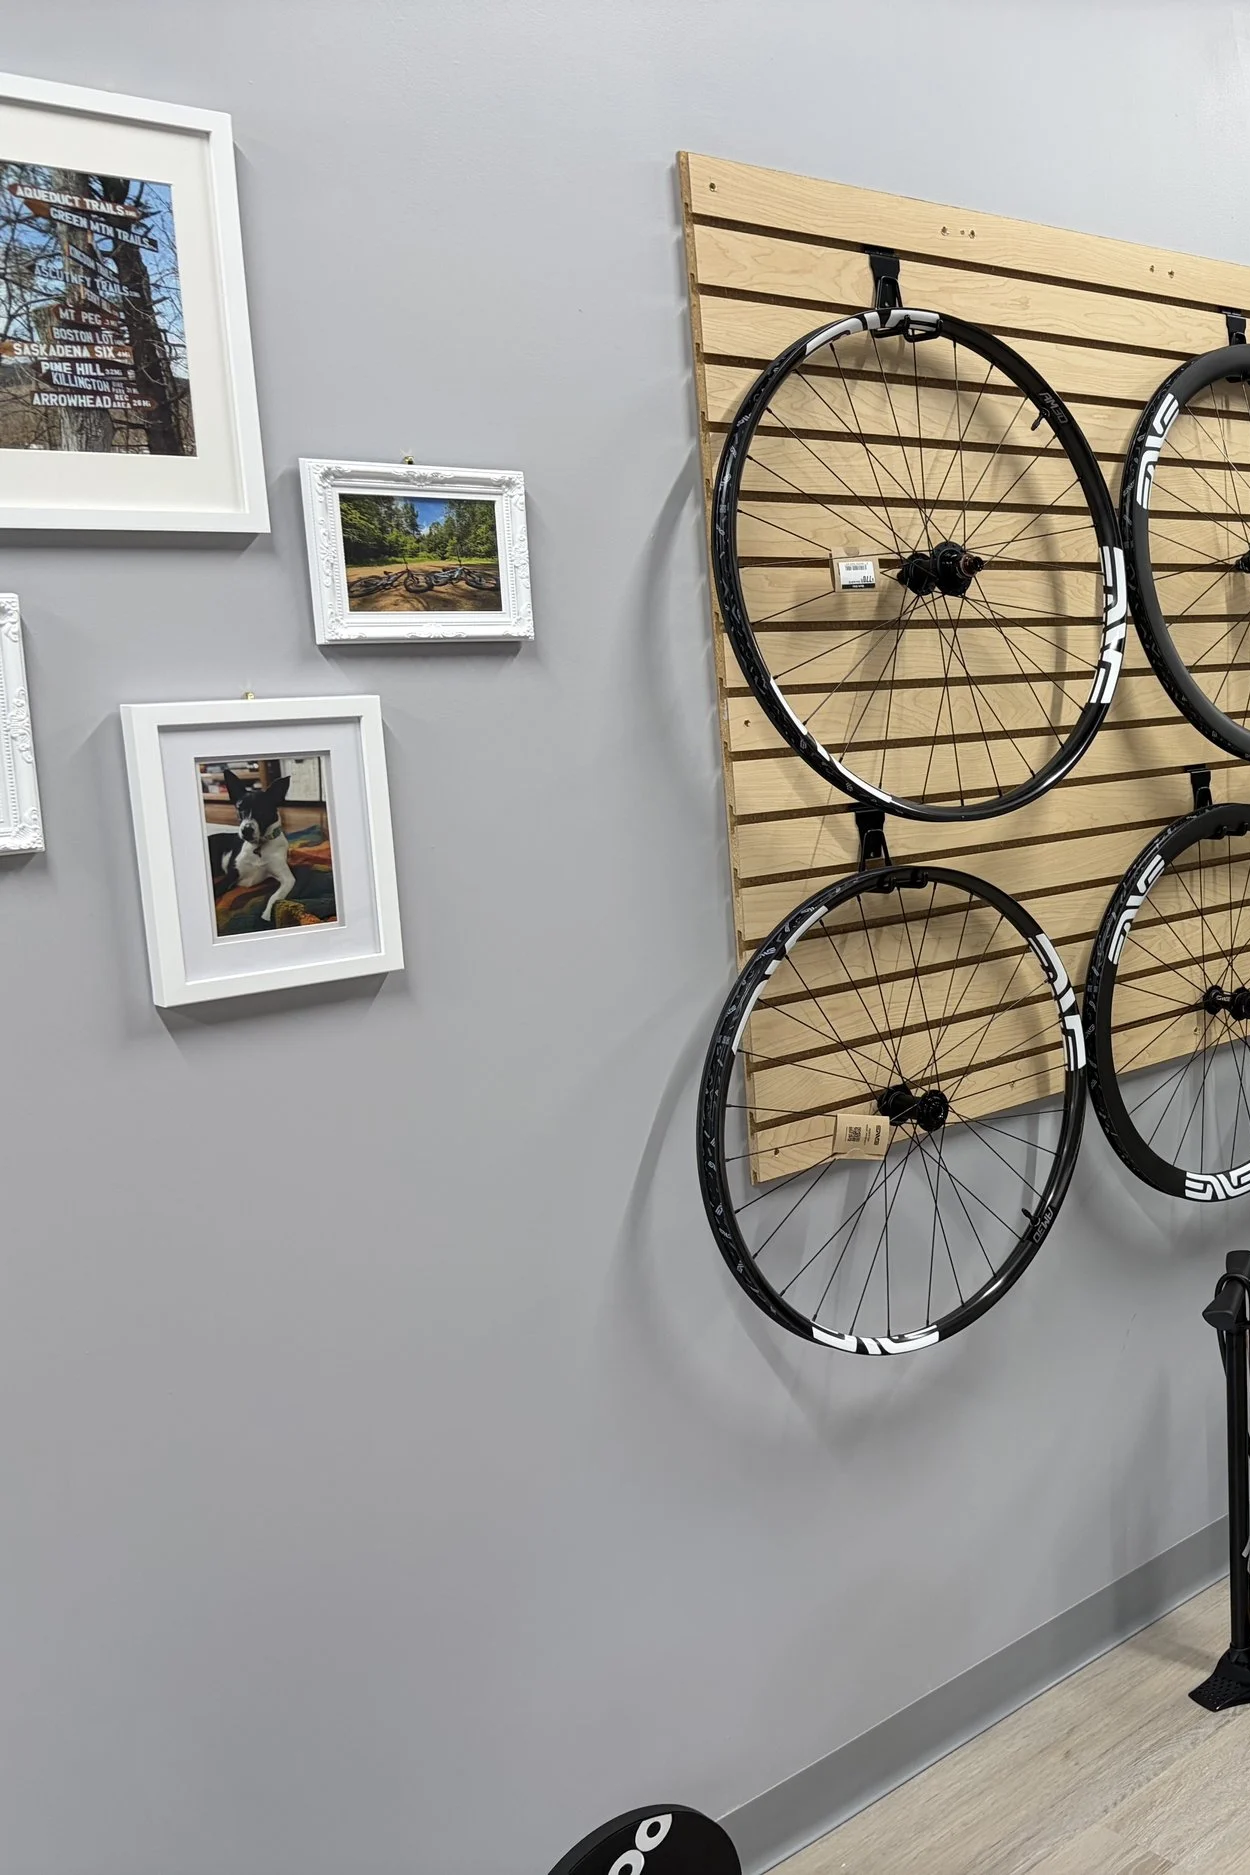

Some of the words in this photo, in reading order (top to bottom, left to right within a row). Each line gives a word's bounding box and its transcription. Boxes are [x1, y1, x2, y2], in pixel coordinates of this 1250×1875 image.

[16, 185, 81, 208] AQUEDUCT
[83, 198, 125, 216] TRAILS
[50, 207, 88, 230] GREEN
[89, 219, 115, 238] MTN
[116, 228, 150, 249] TRAILS
[34, 264, 92, 288] ASCUTNEY
[94, 277, 130, 297] TRAILS
[58, 307, 76, 321] MT
[81, 311, 102, 325] PEG
[52, 326, 93, 342] BOSTON
[95, 332, 115, 345] LOT
[13, 342, 91, 359] SASKADENA
[95, 345, 116, 359] SIX
[41, 361, 71, 374] PINE
[76, 362, 105, 376] HILL
[51, 371, 111, 393] KILLINGTON
[32, 392, 112, 408] ARROWHEAD
[112, 401, 132, 409] AREA
